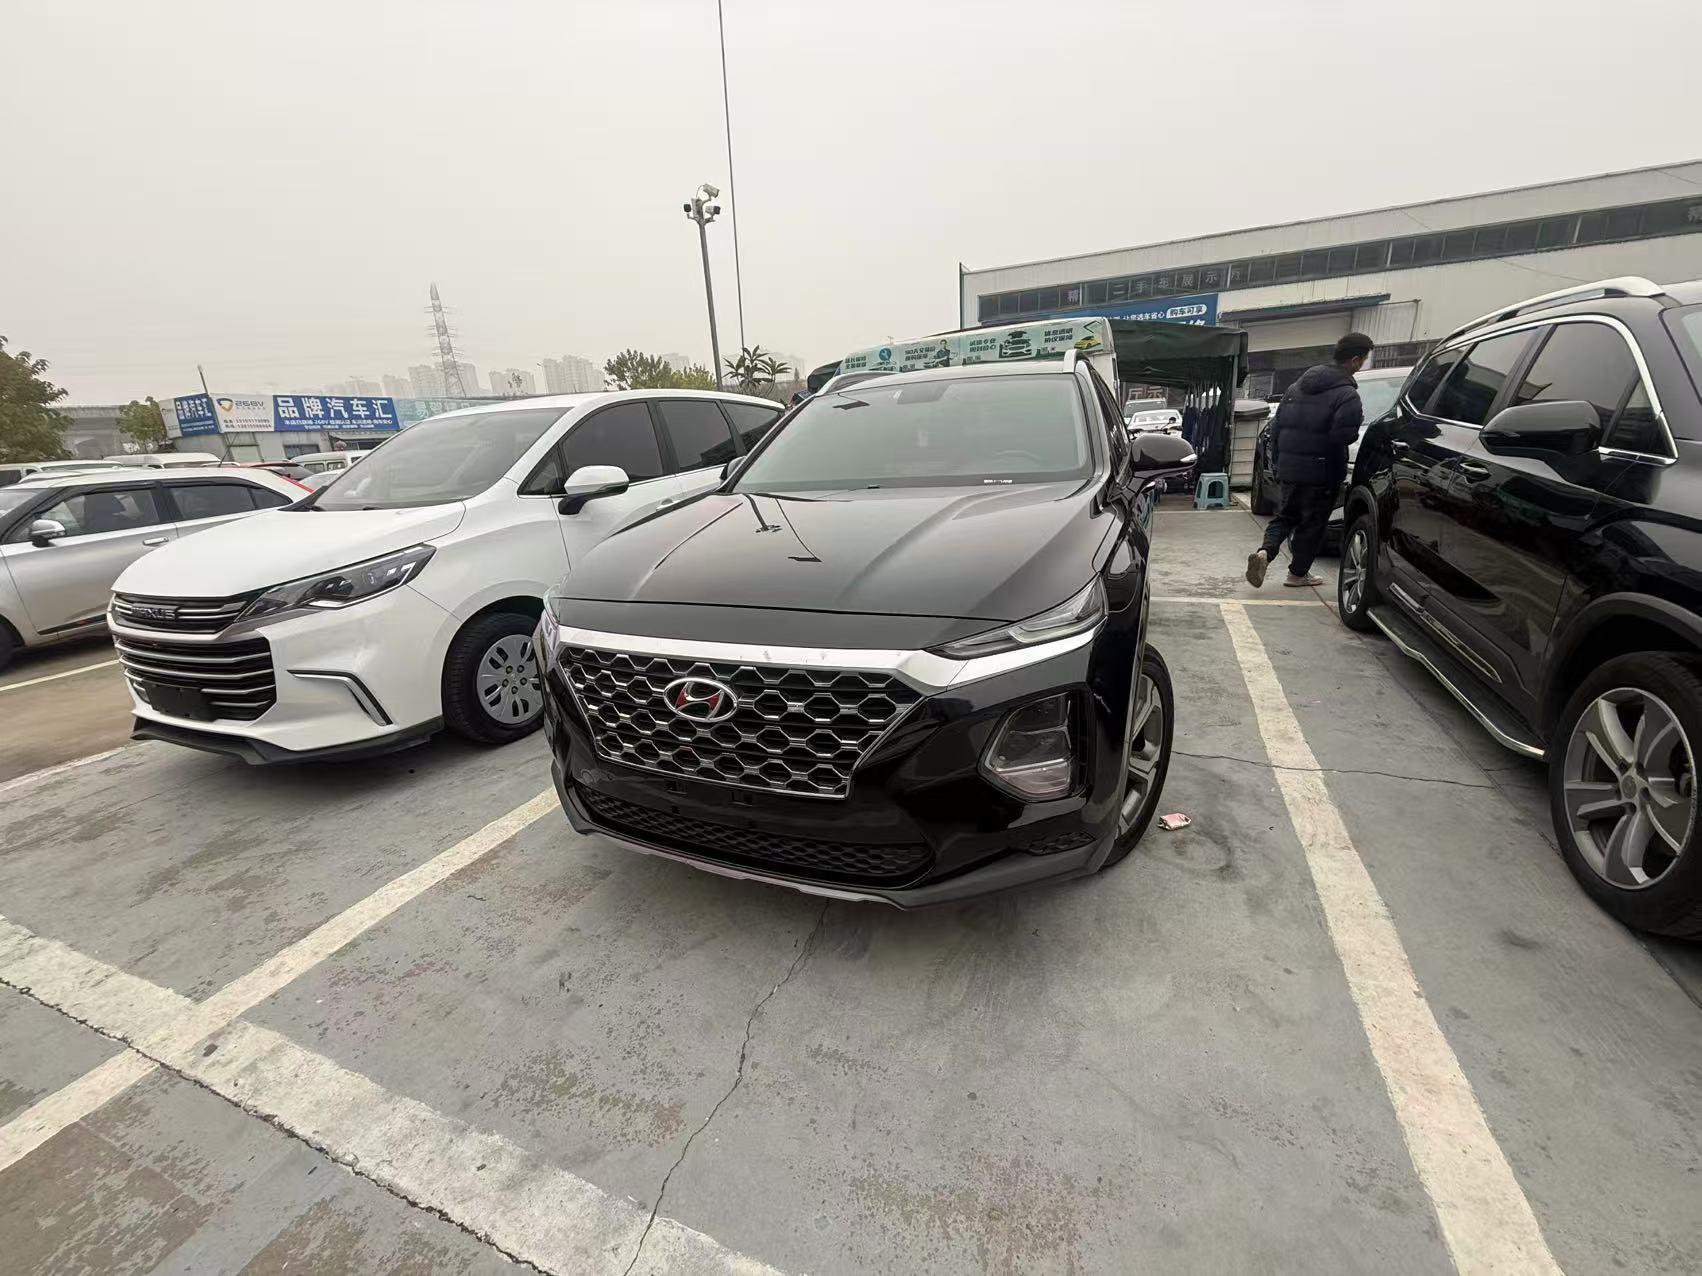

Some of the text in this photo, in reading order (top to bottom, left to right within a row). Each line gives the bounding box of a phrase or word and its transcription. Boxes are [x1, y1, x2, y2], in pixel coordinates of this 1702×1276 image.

[276, 397, 392, 418] 品牌汽车汇
